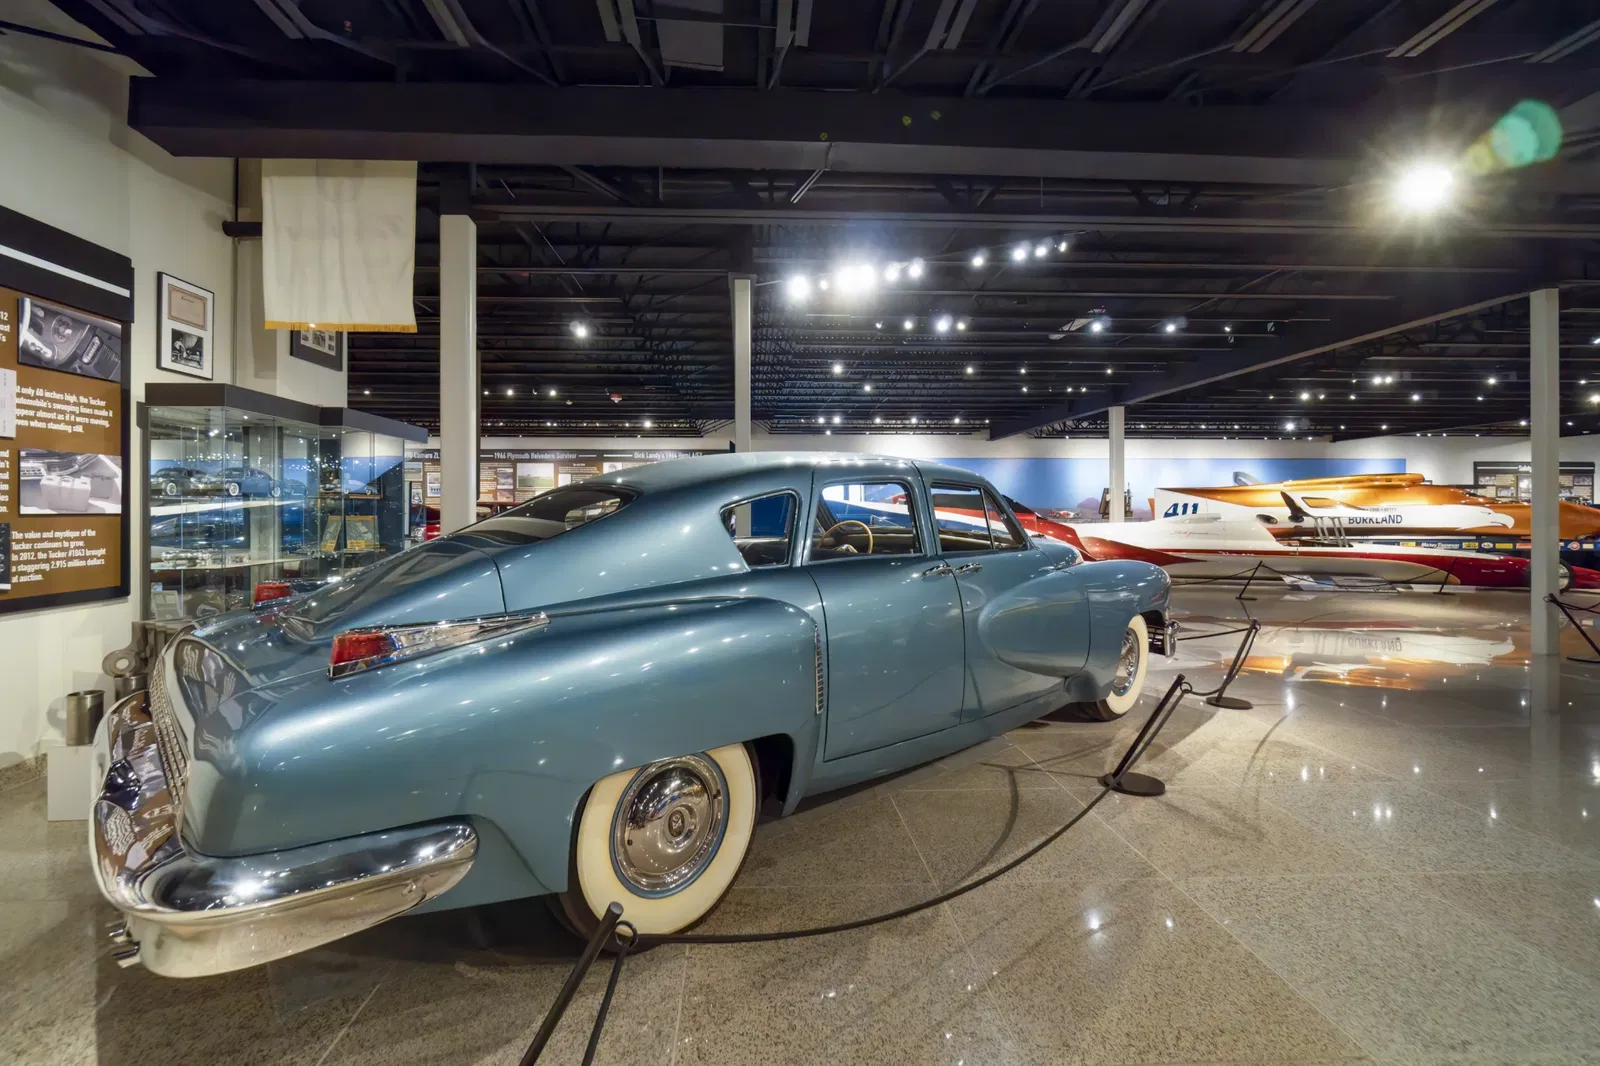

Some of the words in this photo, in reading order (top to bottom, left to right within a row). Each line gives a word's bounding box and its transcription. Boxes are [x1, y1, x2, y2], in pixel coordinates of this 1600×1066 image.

[21, 387, 35, 397] only
[36, 388, 44, 396] 60
[45, 390, 64, 399] inches
[65, 393, 78, 403] high,
[89, 397, 106, 406] Tucker
[53, 403, 79, 414] swooping
[80, 406, 93, 414] lines
[36, 410, 56, 419] almost
[90, 418, 110, 428] moving,
[29, 420, 46, 428] when
[48, 422, 72, 433] standing
[646, 452, 665, 460] Landy's
[1163, 503, 1199, 518] 411
[1348, 515, 1402, 524] BURKLAND
[12, 531, 23, 539] The
[42, 530, 54, 538] and
[55, 529, 80, 539] mystique
[12, 542, 33, 550] Tucker
[34, 541, 62, 549] continues
[12, 553, 18, 561] In
[38, 551, 47, 560] the
[86, 548, 106, 557] brought
[18, 562, 50, 573] staggering
[51, 560, 67, 569] 2.915
[19, 573, 44, 582] auction.
